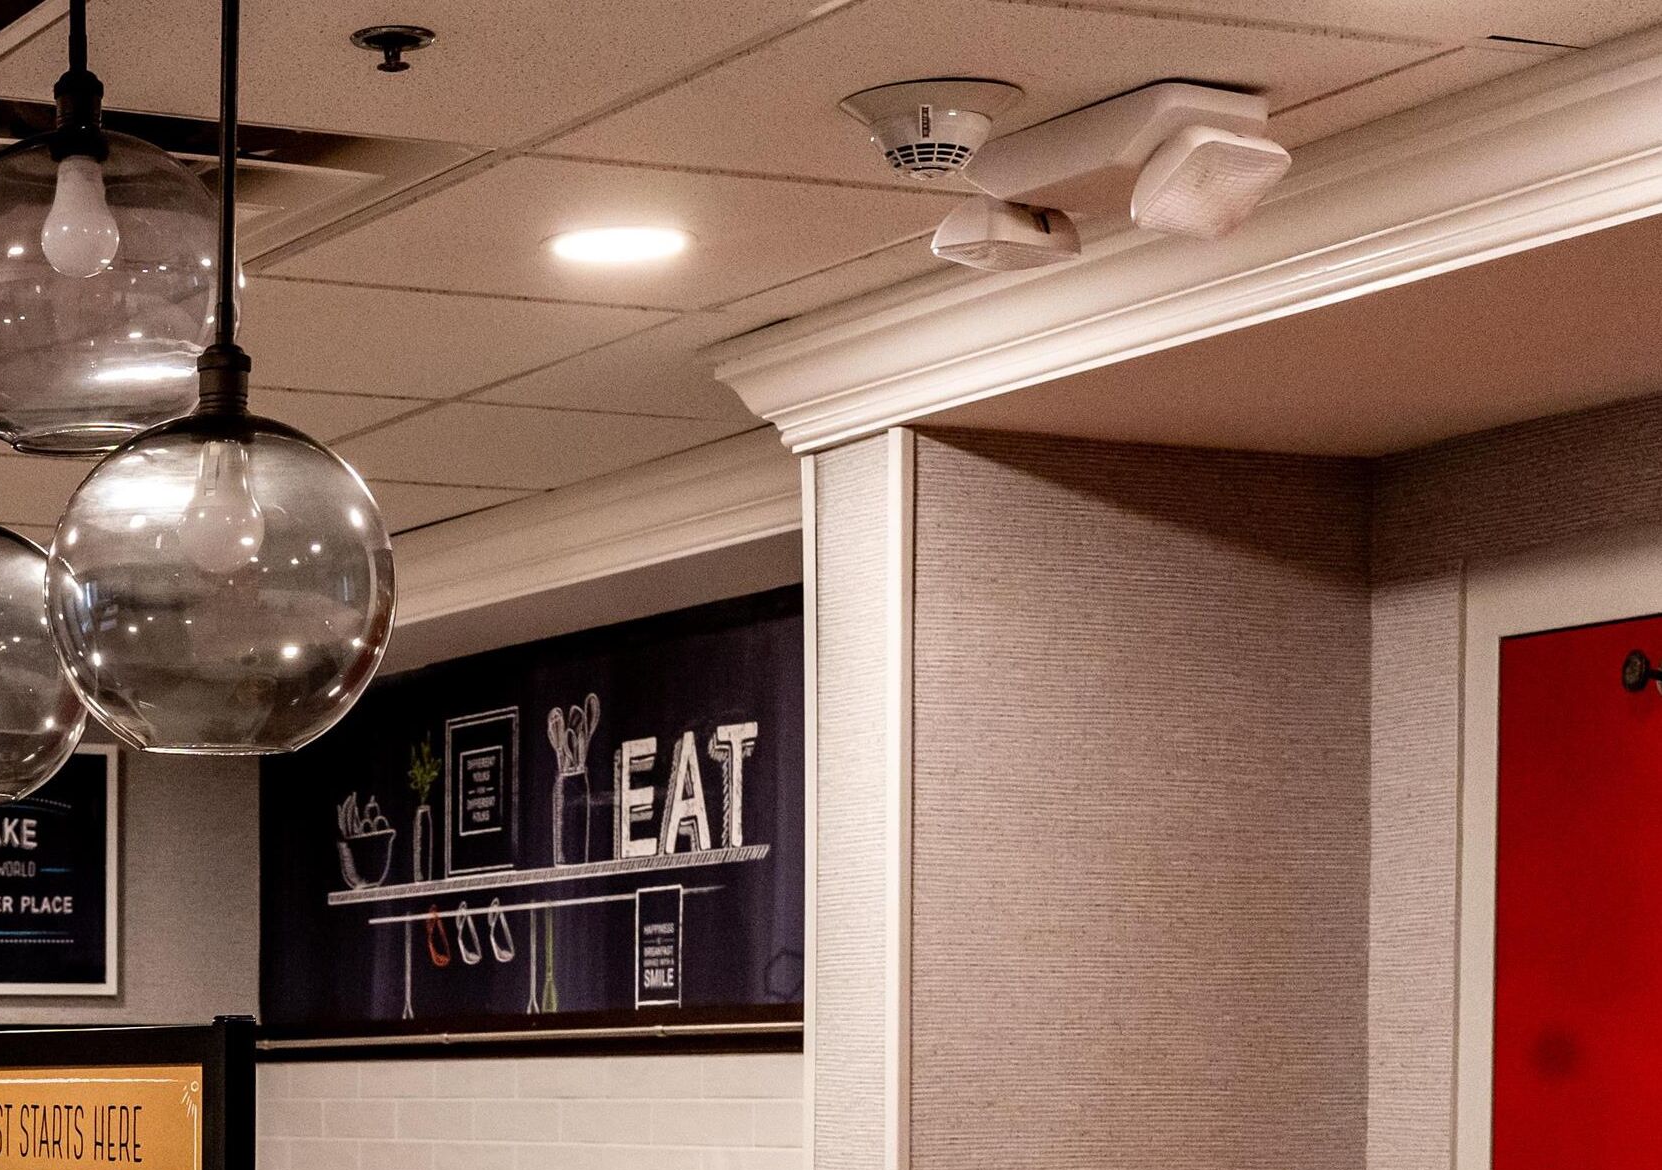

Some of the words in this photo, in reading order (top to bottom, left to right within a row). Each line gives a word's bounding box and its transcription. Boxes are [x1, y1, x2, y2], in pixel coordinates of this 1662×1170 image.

[614, 721, 758, 859] EAT
[21, 896, 73, 914] PLACE
[644, 968, 674, 988] SMILE
[20, 1104, 84, 1160] STARTS
[94, 1105, 143, 1163] HERE
